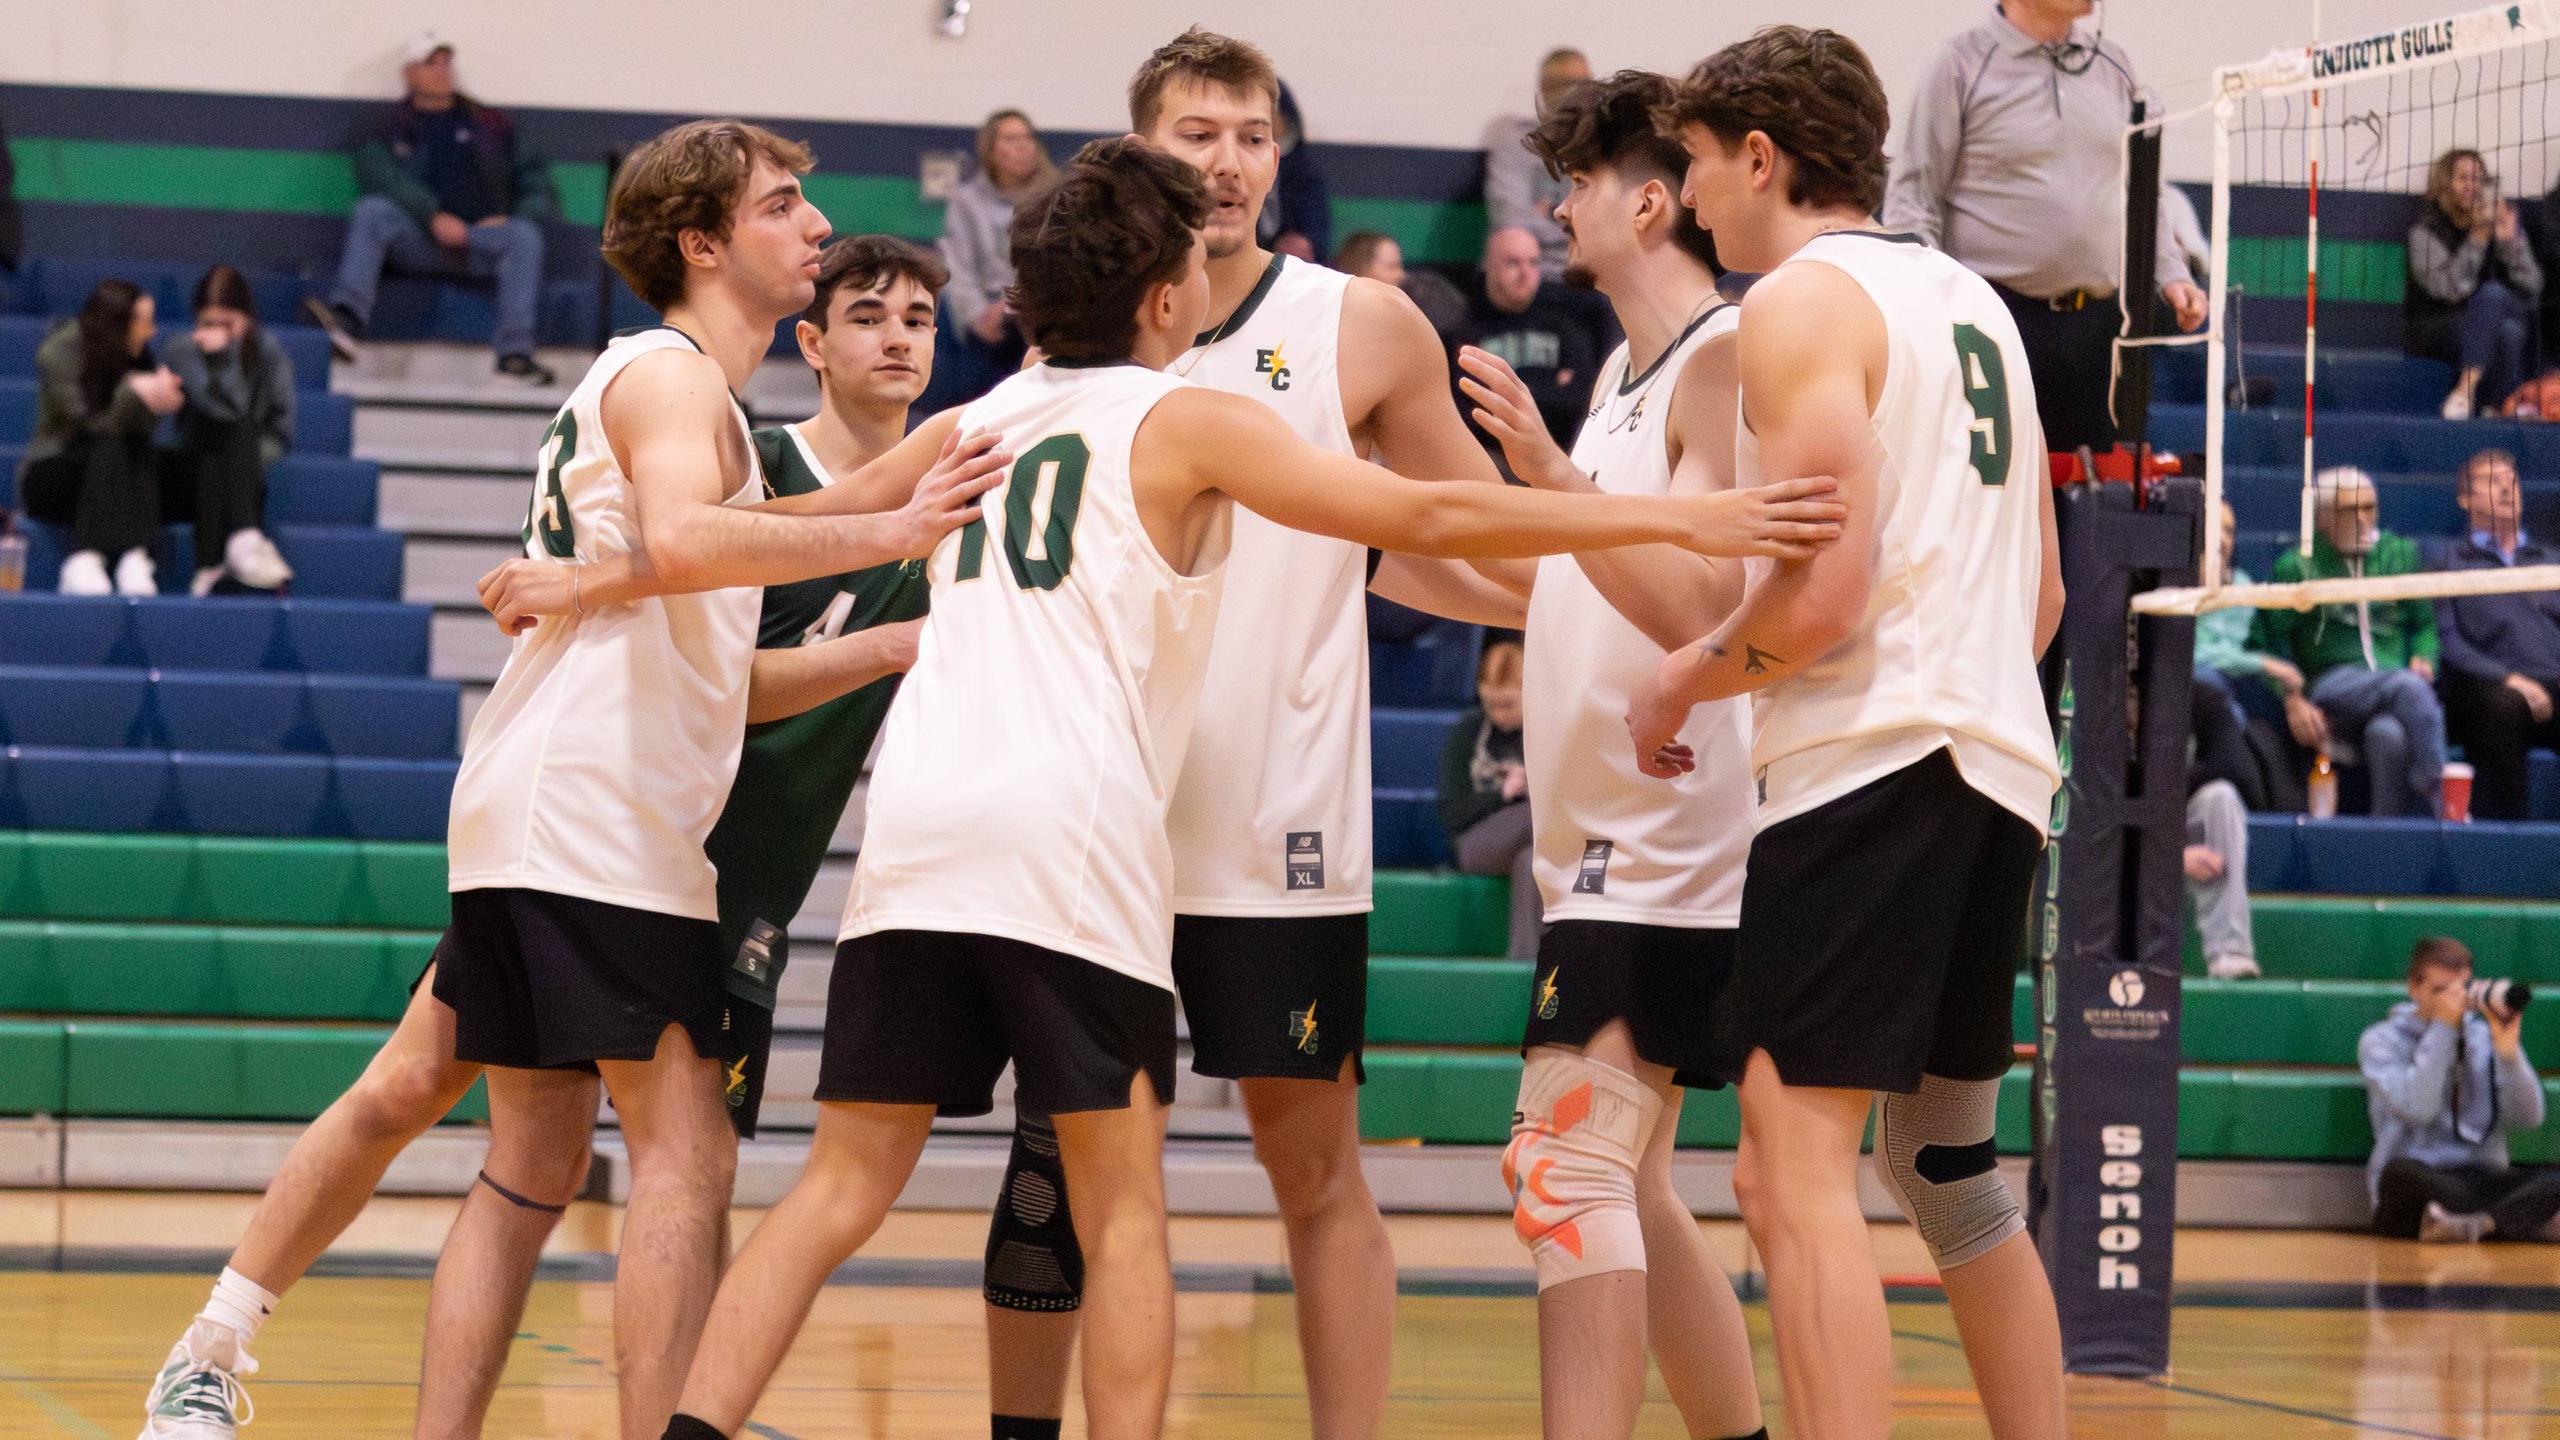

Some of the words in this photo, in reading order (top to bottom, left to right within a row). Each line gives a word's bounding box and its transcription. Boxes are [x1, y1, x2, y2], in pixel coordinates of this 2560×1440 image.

[2401, 20, 2454, 61] GULLS
[1951, 320, 2013, 490] 9
[1295, 871, 1315, 886] XL
[1583, 875, 1591, 889] L
[748, 957, 756, 971] S
